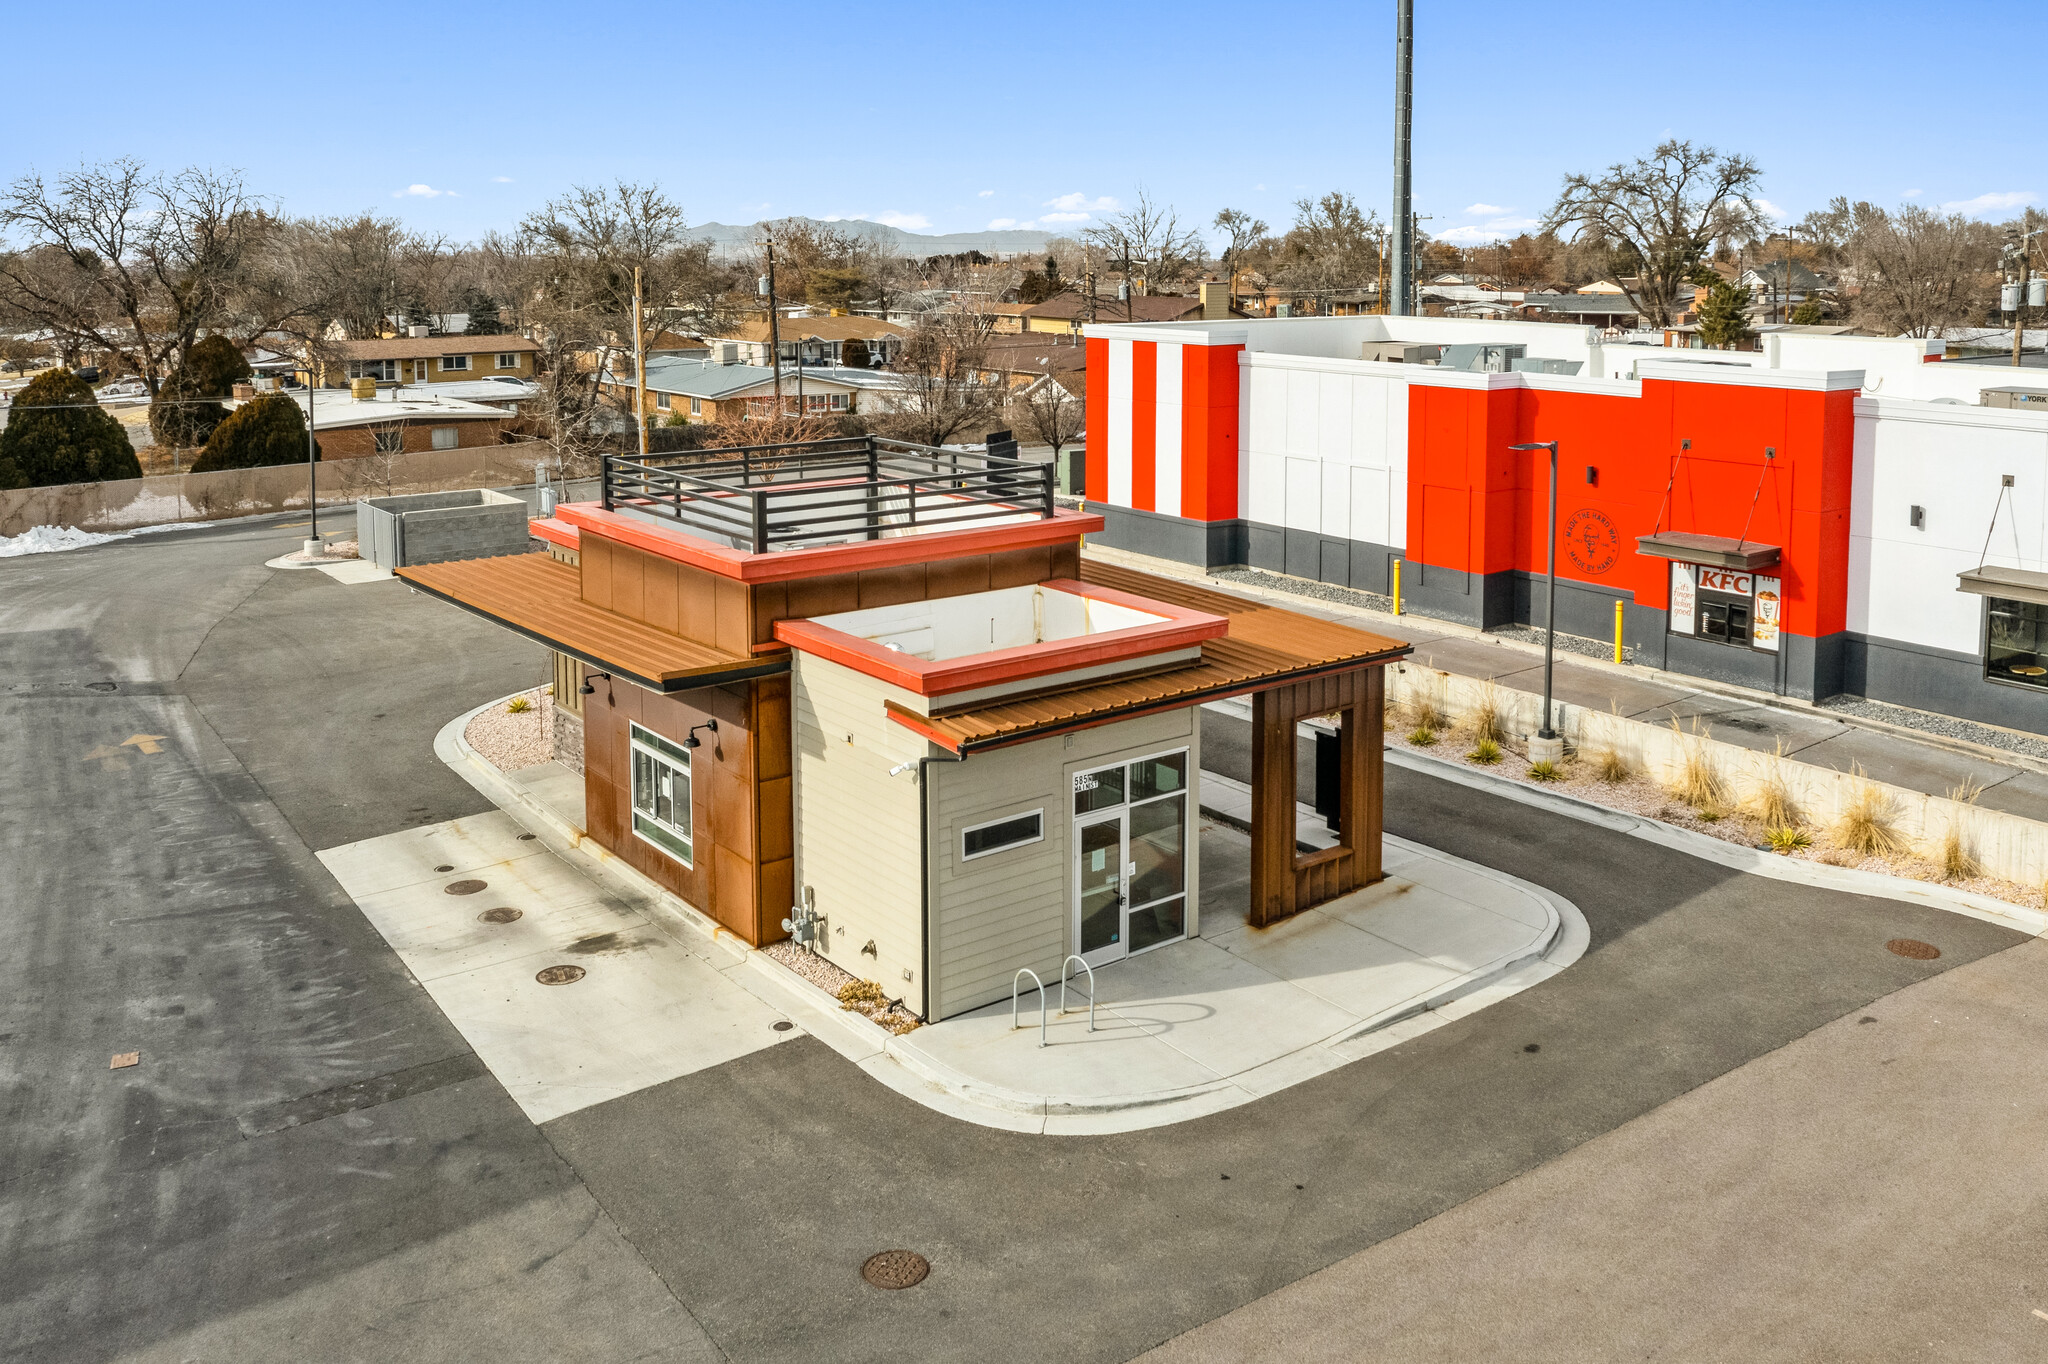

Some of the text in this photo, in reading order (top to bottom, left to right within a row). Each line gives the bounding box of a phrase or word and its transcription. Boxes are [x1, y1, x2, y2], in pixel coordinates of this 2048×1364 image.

[2027, 395, 2047, 403] YORK
[1566, 511, 1617, 545] MADE THE HARD WAY
[1570, 551, 1585, 568] MADE
[1597, 556, 1613, 571] HAND
[1700, 570, 1749, 594] KFC
[1673, 586, 1694, 599] finger
